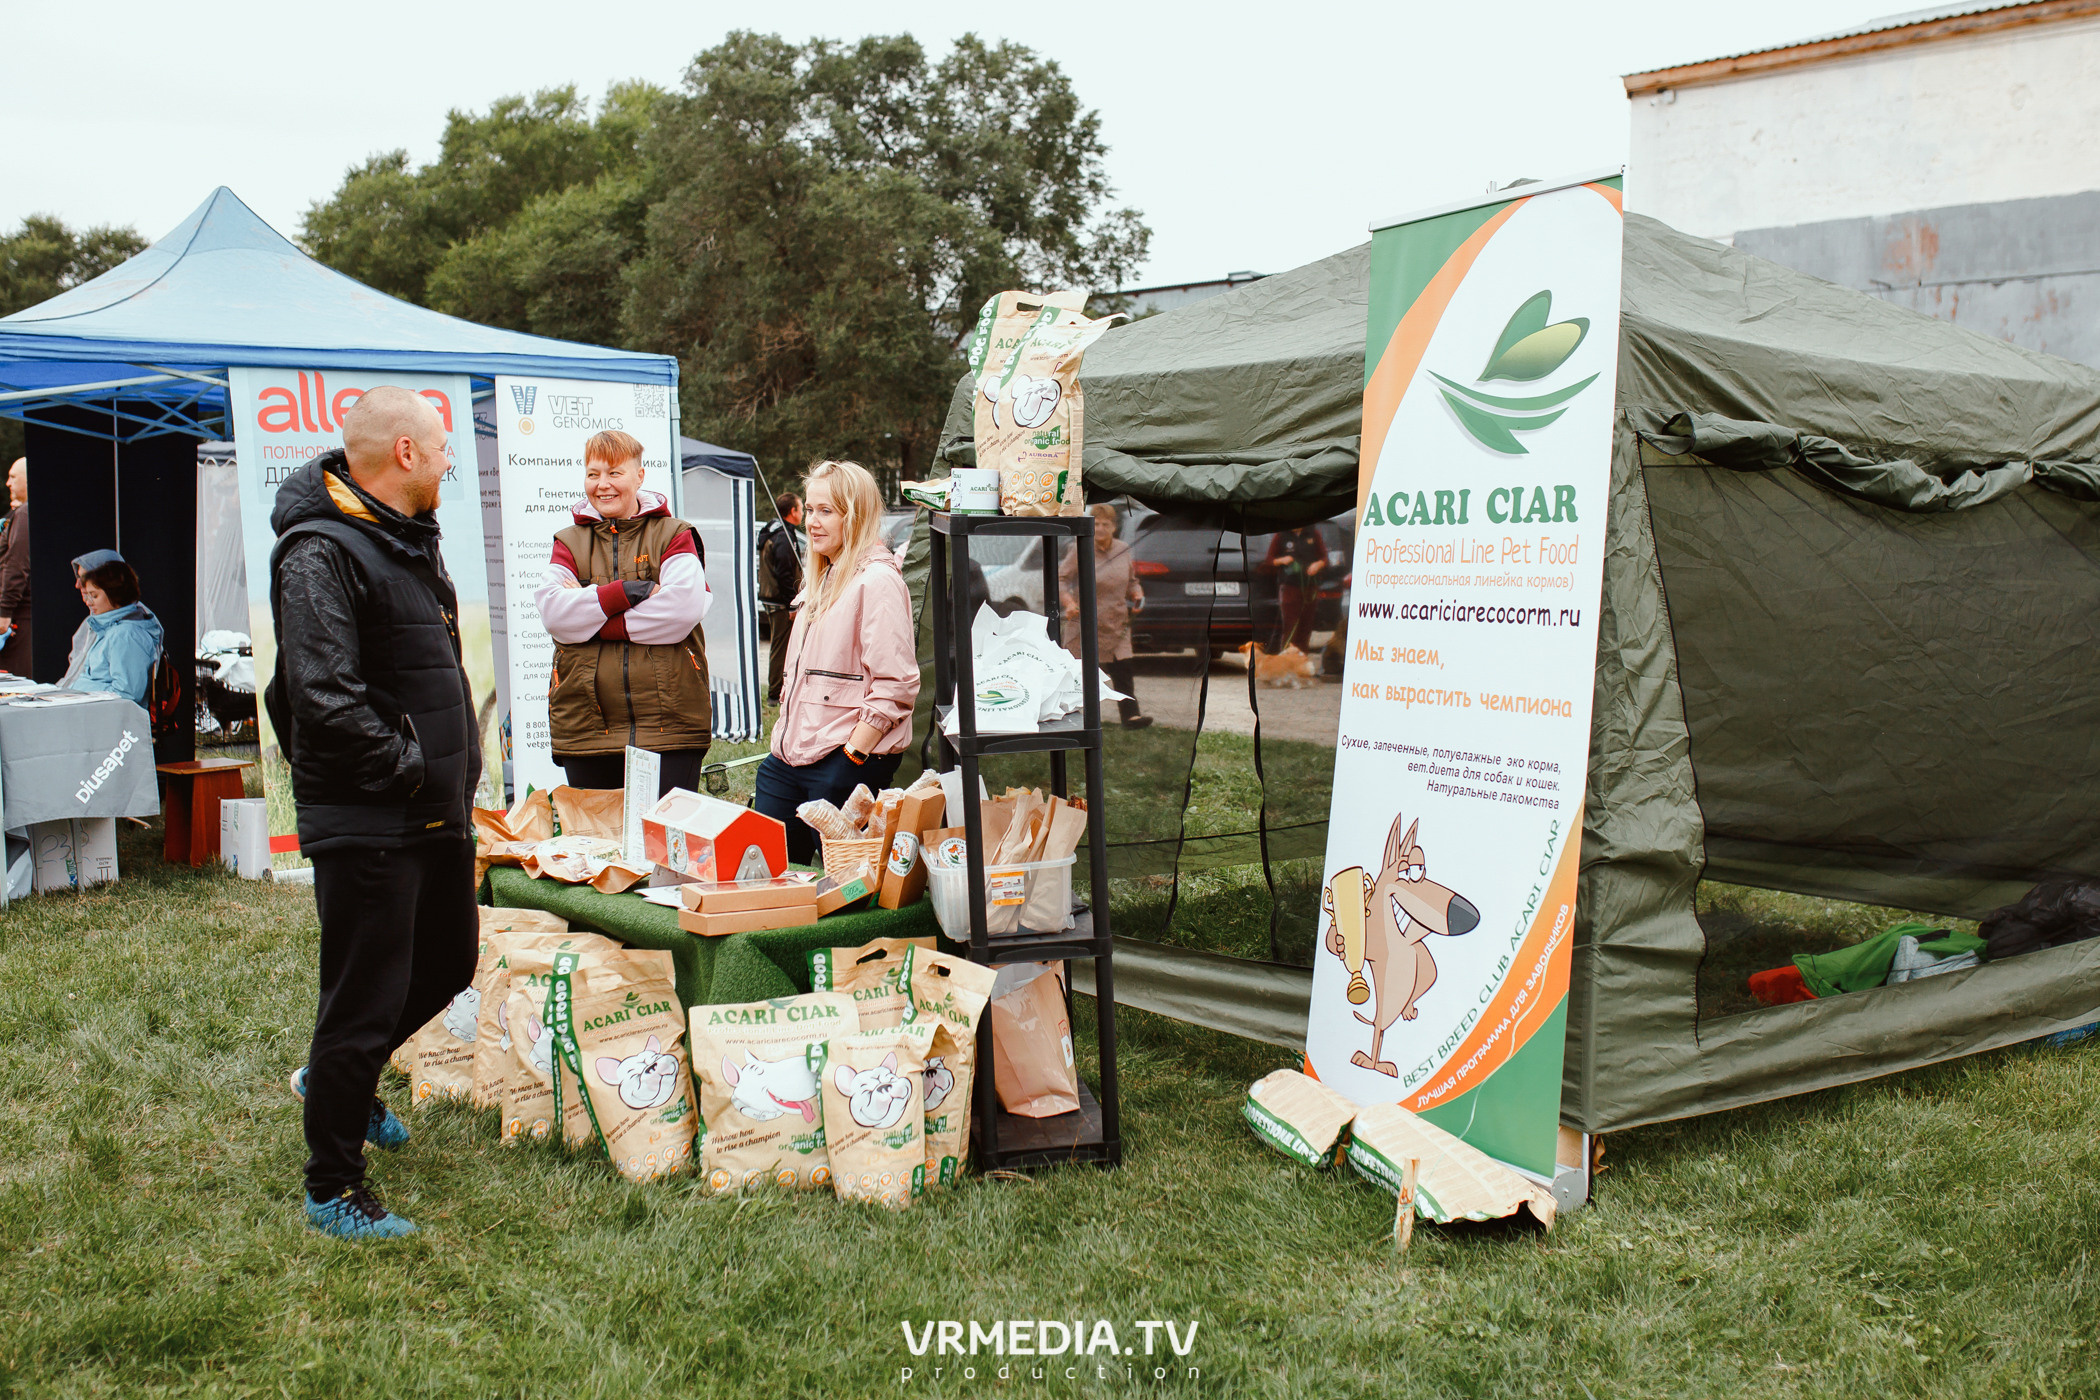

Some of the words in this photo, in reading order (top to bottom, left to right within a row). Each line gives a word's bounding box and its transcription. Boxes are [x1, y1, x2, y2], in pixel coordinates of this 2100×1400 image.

[969, 337, 987, 366] DOG
[995, 338, 1021, 349] ACA
[548, 395, 593, 416] VET
[553, 416, 624, 430] GENOMICS
[1024, 438, 1050, 446] organic
[1032, 429, 1060, 438] natural
[508, 453, 573, 466] Компания
[538, 488, 587, 499] Генетиче
[525, 504, 546, 513] для
[548, 504, 574, 514] дома
[1363, 488, 1471, 527] ACARI
[1486, 484, 1579, 525] CIAR
[517, 540, 554, 549] Исследо
[1366, 538, 1456, 565] Professional
[1460, 538, 1495, 564] Line
[1501, 536, 1531, 565] Pet
[1539, 534, 1579, 565] Food
[1365, 570, 1471, 589] (профессиональная
[1473, 571, 1523, 588] линейка
[1526, 571, 1574, 592] кормов)
[1358, 599, 1581, 627] www.acariciarecocorm.ru
[521, 630, 548, 639] Совре
[1354, 638, 1385, 662] Мы
[1391, 646, 1445, 670] знаем,
[1352, 682, 1380, 699] как
[1385, 684, 1472, 710] вырастить
[1479, 692, 1572, 718] чемпиона
[527, 741, 550, 749] vetge
[1341, 734, 1371, 751] Сухие,
[1373, 740, 1430, 758] запеченные,
[1432, 748, 1502, 766] полувлажные
[1506, 757, 1525, 768] эко
[1527, 758, 1562, 775] корма,
[75, 729, 139, 805] Diusapet
[1407, 761, 1460, 778] вет.диета
[1462, 766, 1481, 781] для
[1483, 770, 1513, 786] собак
[1516, 777, 1523, 787] и
[1525, 778, 1560, 792] кошек.
[1426, 779, 1504, 801] Натуральные
[1499, 791, 1560, 810] лакомства
[1402, 1055, 1434, 1089] BEST
[1437, 1007, 1478, 1060] BREED
[1479, 954, 1511, 1004] CLUB
[1510, 885, 1543, 952] ACARI
[1538, 819, 1562, 877] CIAR
[848, 985, 890, 1000] CARI
[1416, 1074, 1457, 1109] ЛУЧШАЯ
[1455, 1017, 1512, 1081] ПРОГРАММА
[1510, 988, 1529, 1020] ДЛЯ
[1526, 903, 1570, 991] ЗАВОДЧИКОВ
[583, 1008, 631, 1032] ACARI
[636, 1000, 672, 1017] CIAR
[708, 1008, 777, 1026] ACARI
[786, 1005, 840, 1022] CIAR
[418, 1051, 428, 1060] We
[431, 1057, 443, 1067] rise
[450, 1052, 475, 1063] champi
[740, 1128, 755, 1138] how
[791, 1130, 824, 1140] natural
[883, 1126, 912, 1137] natural
[724, 1142, 738, 1152] rise
[745, 1130, 781, 1147] champion
[778, 1139, 814, 1152] organic
